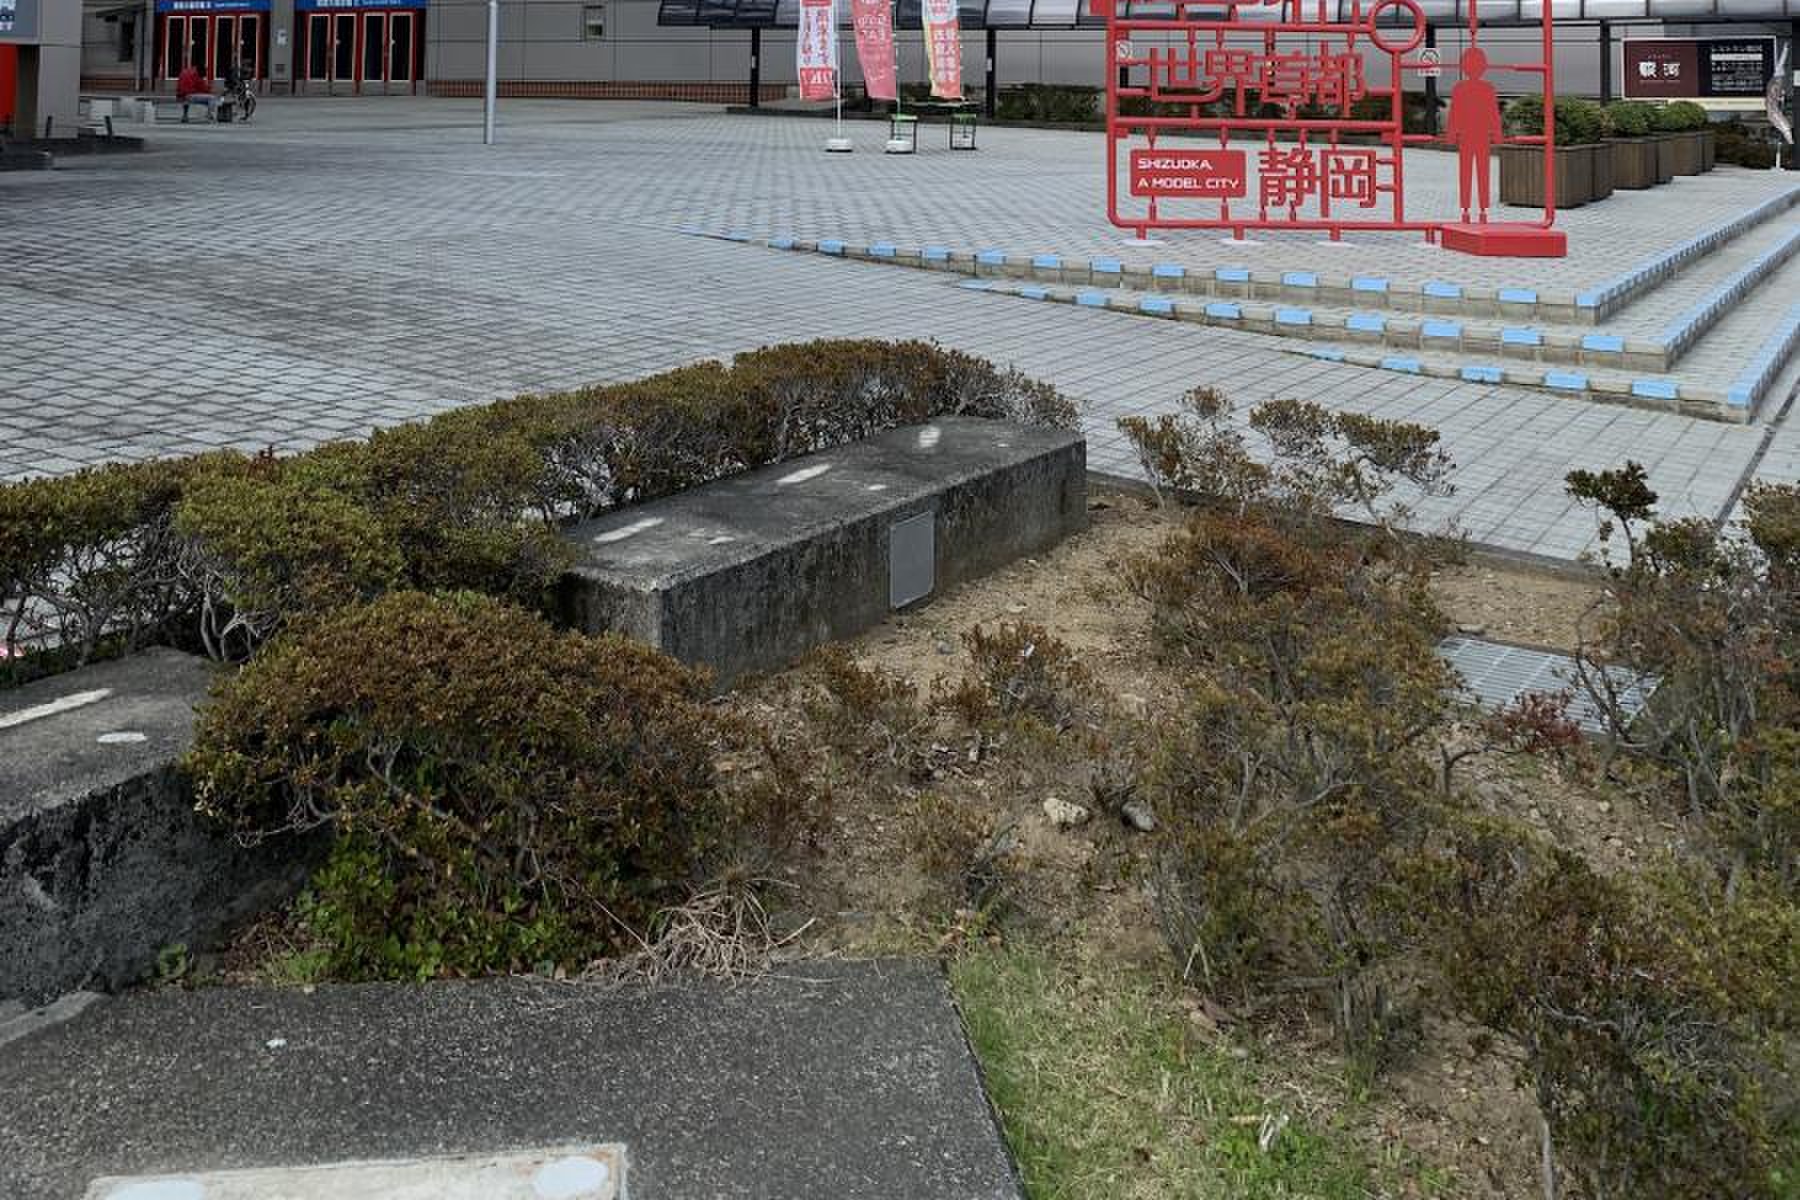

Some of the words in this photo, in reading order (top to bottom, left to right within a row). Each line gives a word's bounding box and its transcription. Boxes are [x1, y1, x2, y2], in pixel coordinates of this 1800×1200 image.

[1141, 42, 1365, 117] 世界首都
[1138, 178, 1149, 188] A
[1152, 178, 1202, 189] MODEL
[1206, 177, 1239, 189] CITY
[1259, 147, 1376, 217] 静岡
